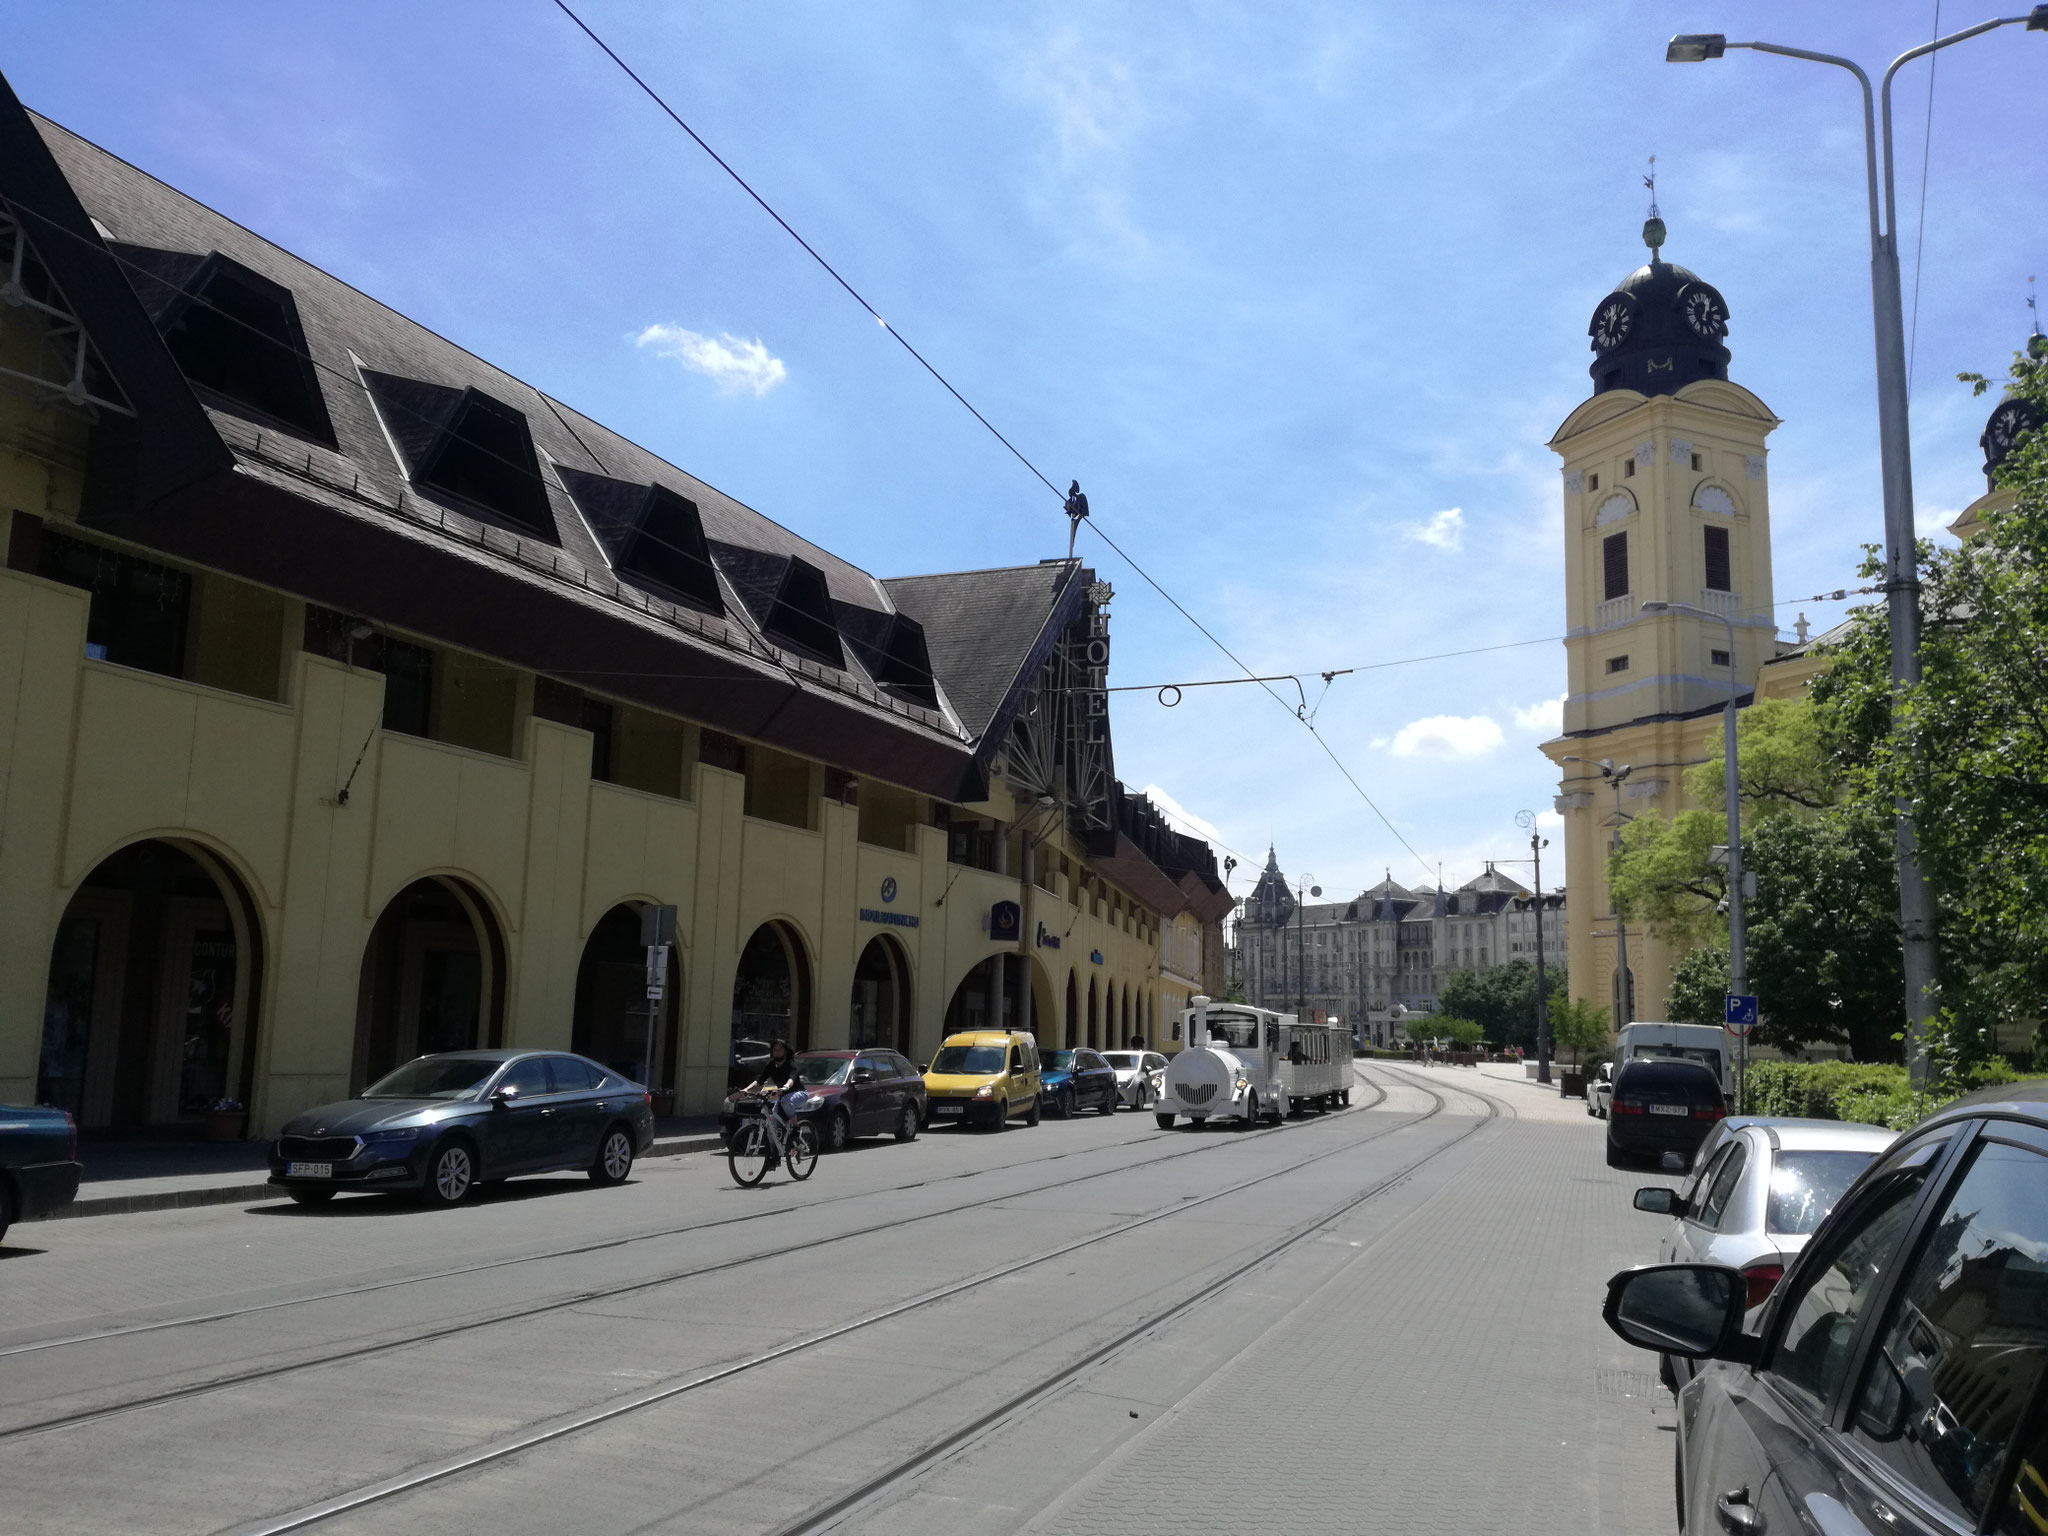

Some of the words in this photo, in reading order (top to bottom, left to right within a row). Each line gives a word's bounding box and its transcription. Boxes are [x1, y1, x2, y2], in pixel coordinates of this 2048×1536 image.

[1086, 614, 1111, 745] HOTEL
[1730, 998, 1741, 1012] P
[292, 1163, 331, 1175] SFP-015
